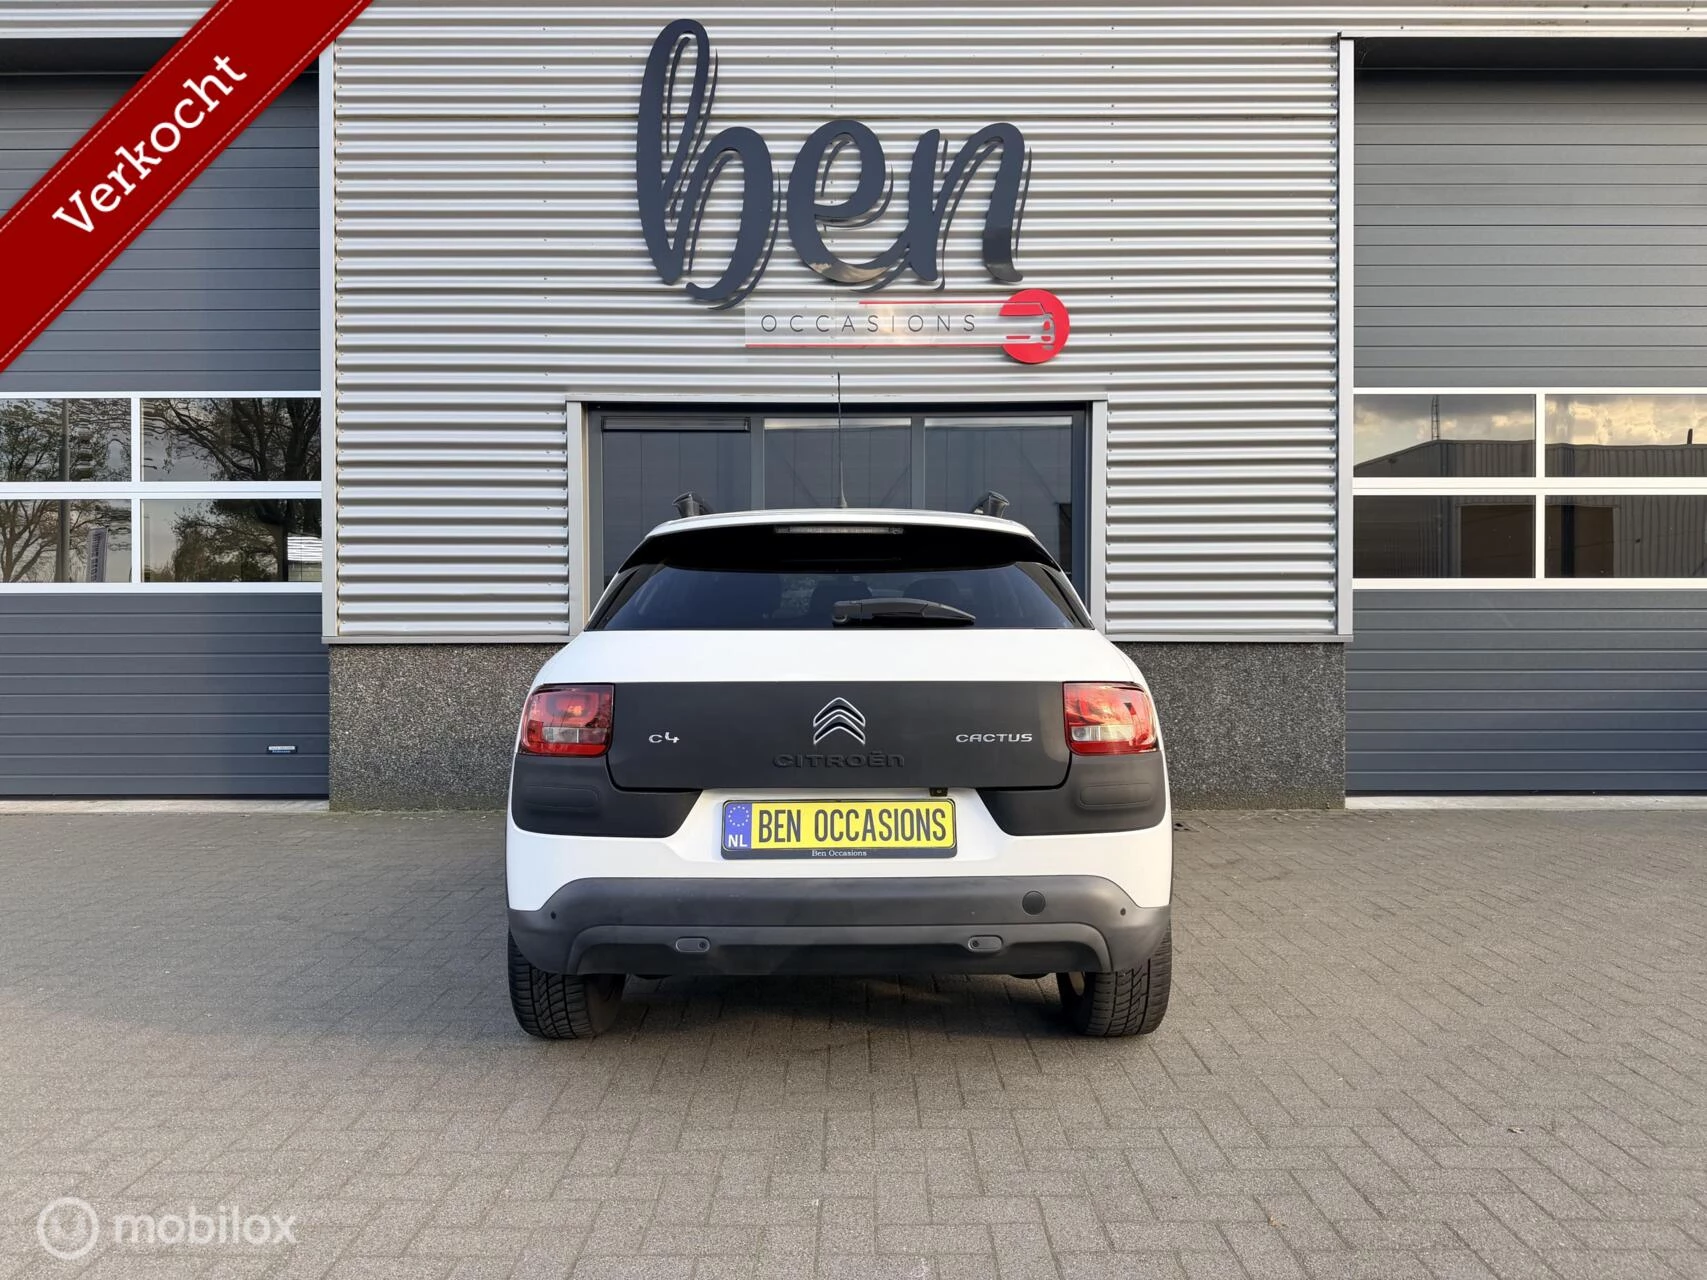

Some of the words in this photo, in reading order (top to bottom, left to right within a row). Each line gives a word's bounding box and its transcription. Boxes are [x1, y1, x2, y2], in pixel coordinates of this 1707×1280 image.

[636, 18, 1031, 304] ben
[760, 313, 976, 333] OCCASIONS
[648, 731, 680, 743] C4
[955, 732, 1033, 743] CACTUS
[758, 809, 801, 843] BEN
[814, 807, 947, 842] OCCASIONS
[728, 834, 748, 848] NL
[811, 849, 827, 857] Ben
[828, 849, 867, 857] Occasions
